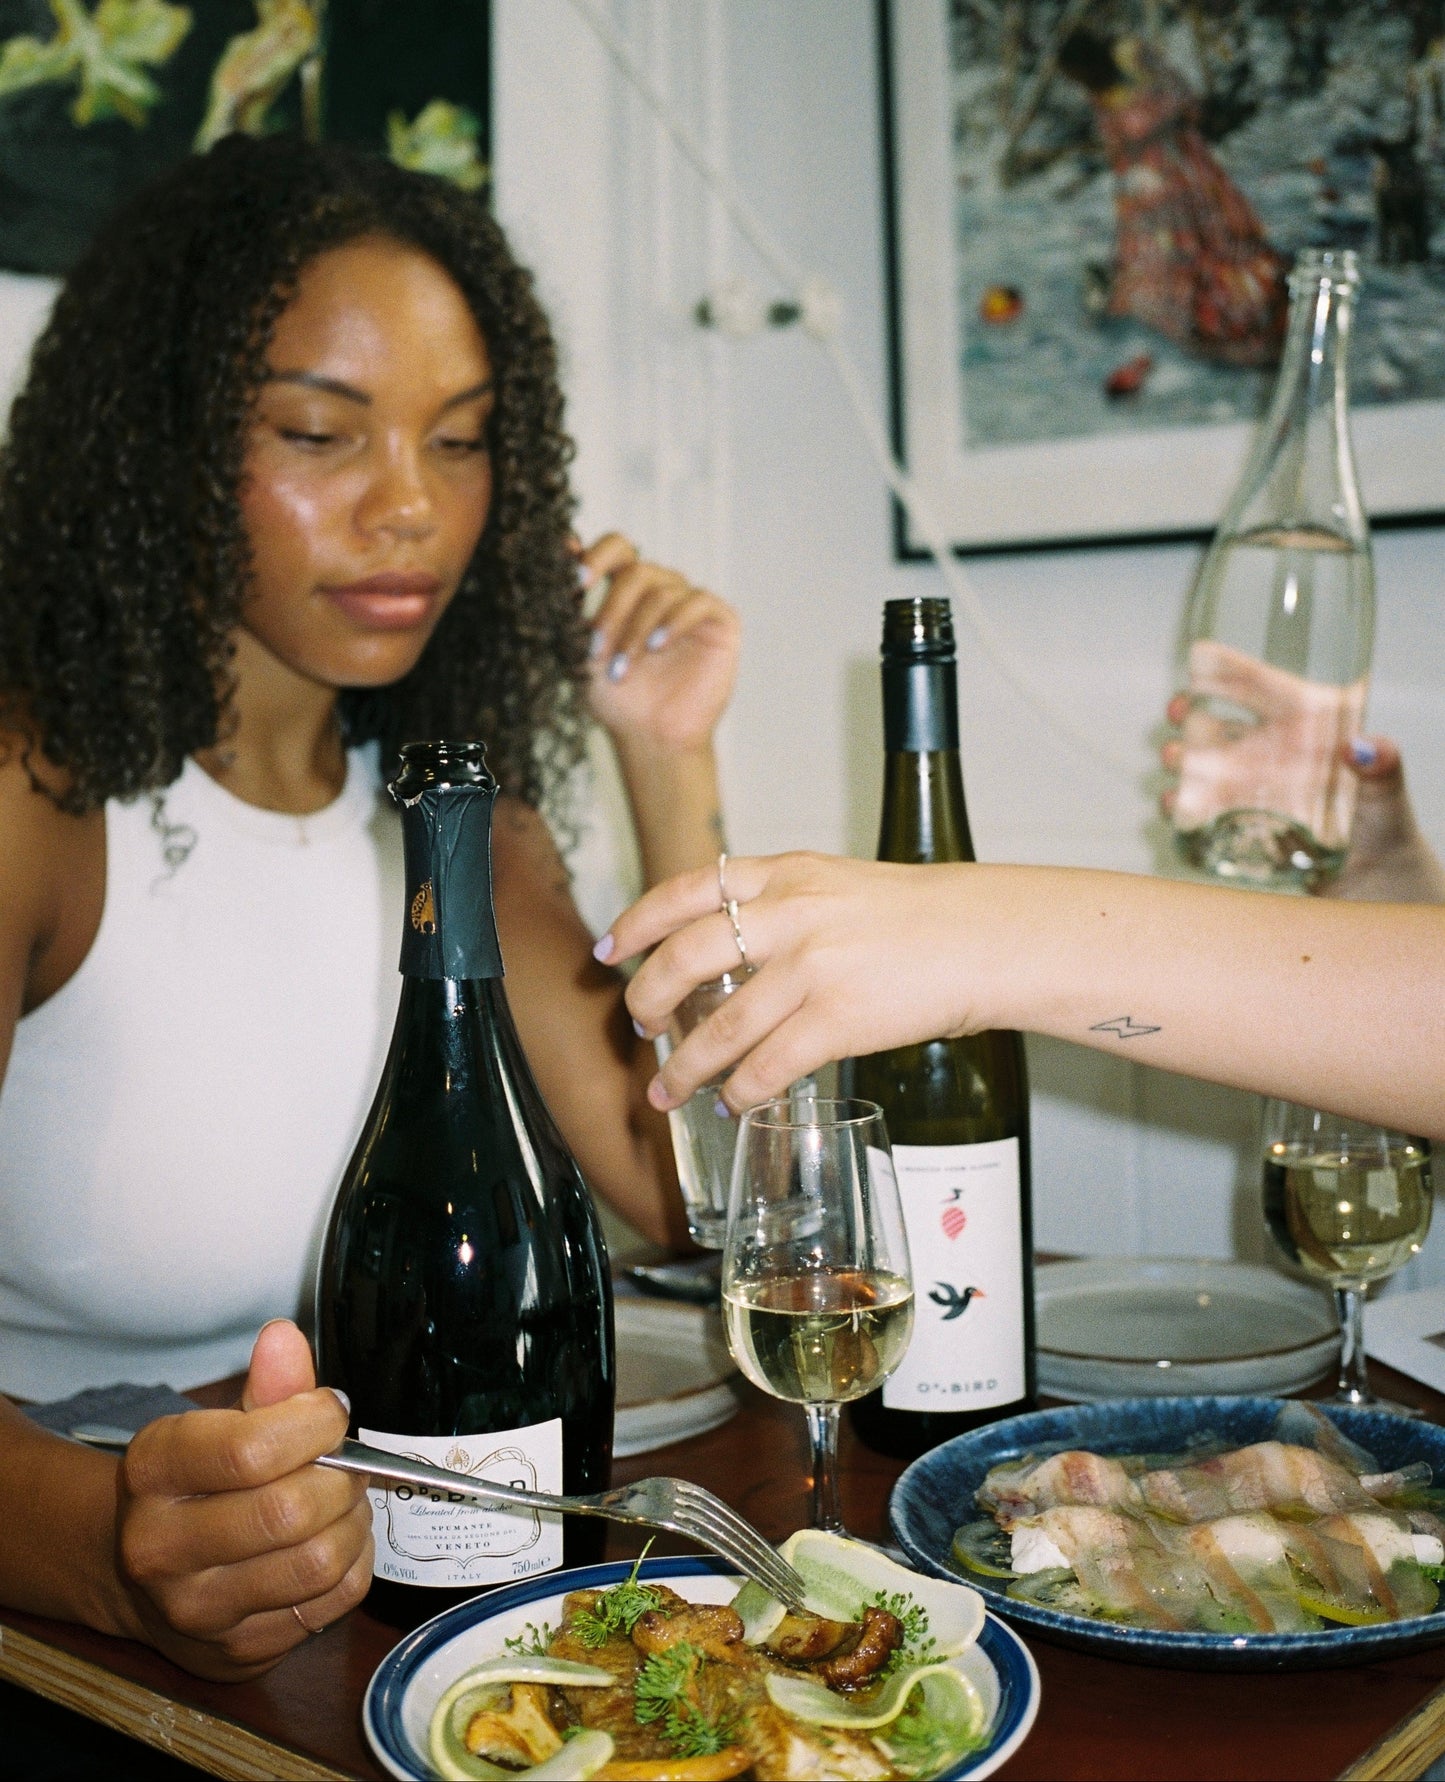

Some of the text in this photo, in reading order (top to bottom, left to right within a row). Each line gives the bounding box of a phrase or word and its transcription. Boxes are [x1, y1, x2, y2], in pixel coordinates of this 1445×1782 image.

[408, 1502, 513, 1518] Liberated from alcohol
[431, 1522, 493, 1532] SPUMANTE
[435, 1541, 491, 1551] VENETO
[447, 1573, 482, 1581] ITALY
